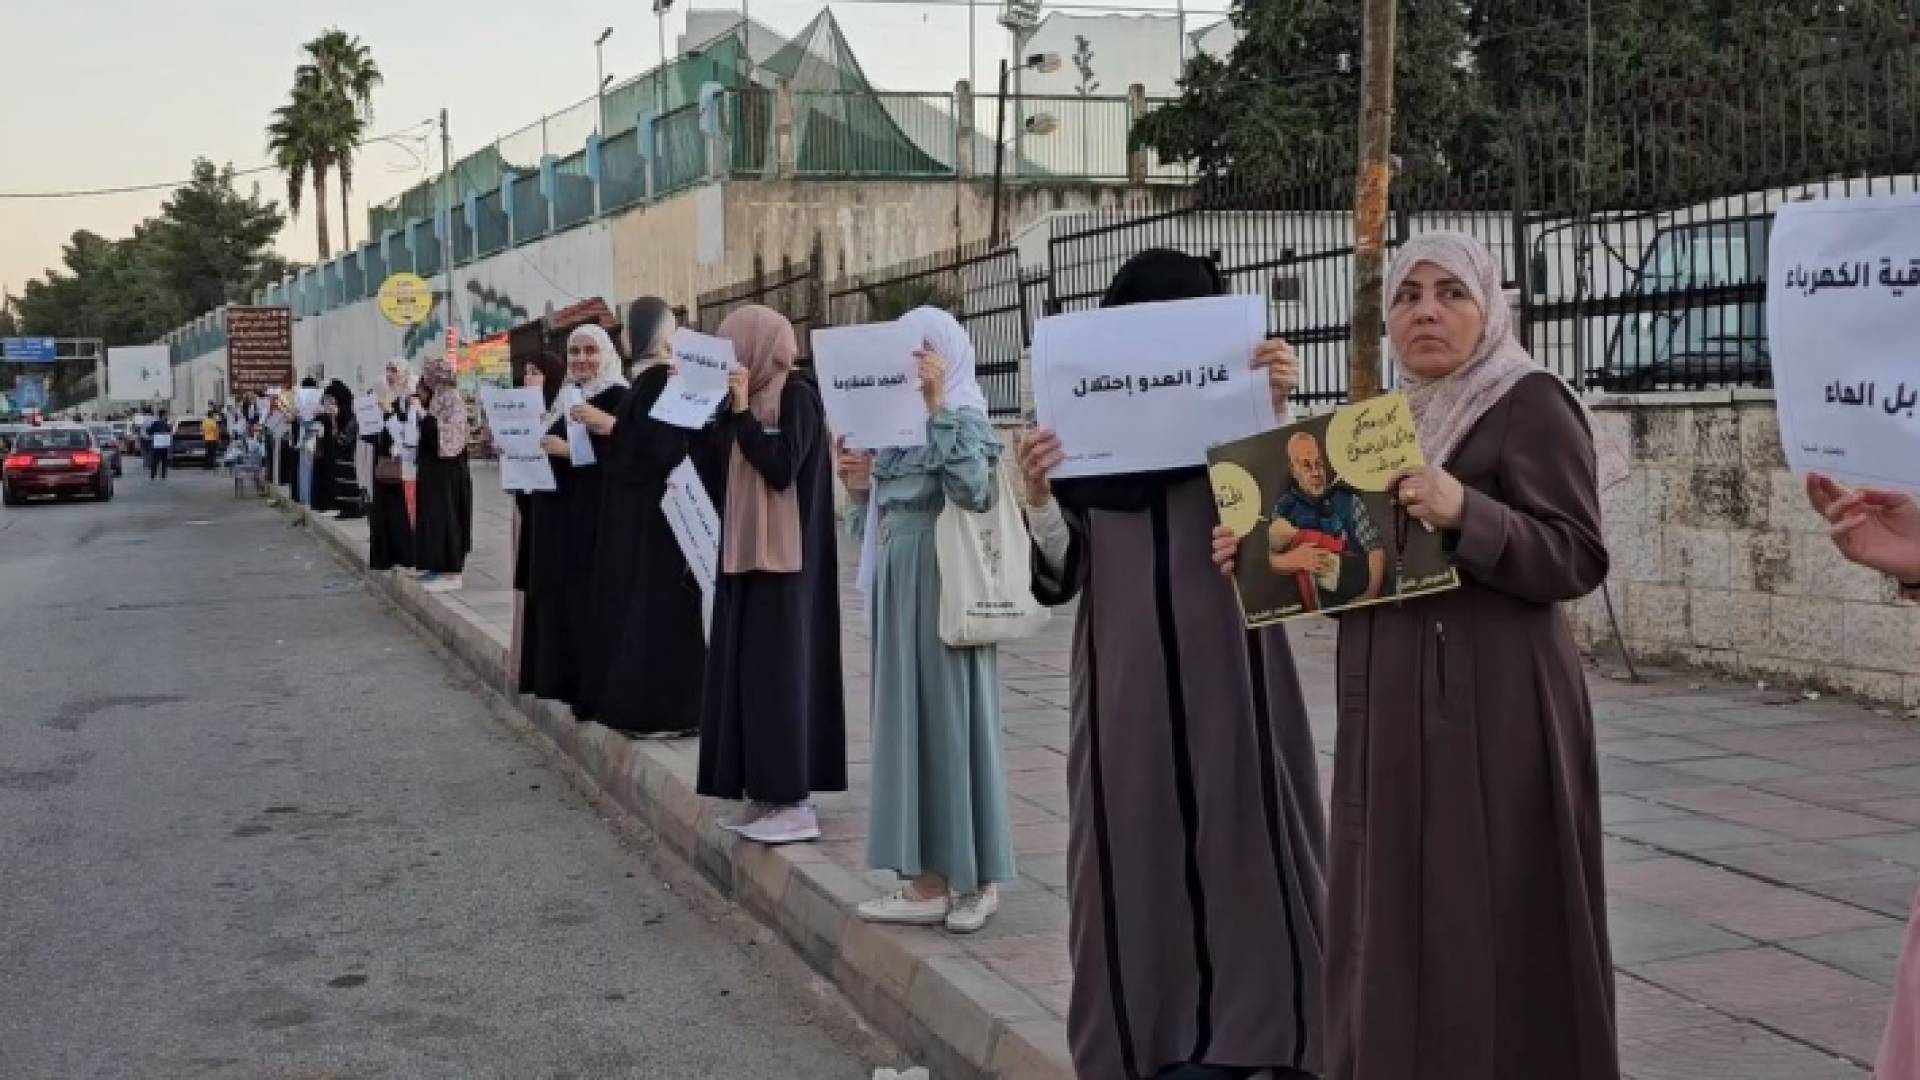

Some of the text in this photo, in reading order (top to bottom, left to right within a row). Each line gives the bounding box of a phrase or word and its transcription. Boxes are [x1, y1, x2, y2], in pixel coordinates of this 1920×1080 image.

[1784, 260, 1869, 297] الكهرباء
[1072, 363, 1230, 398] غاز العدو إحتلال
[1824, 379, 1875, 406] الماء
